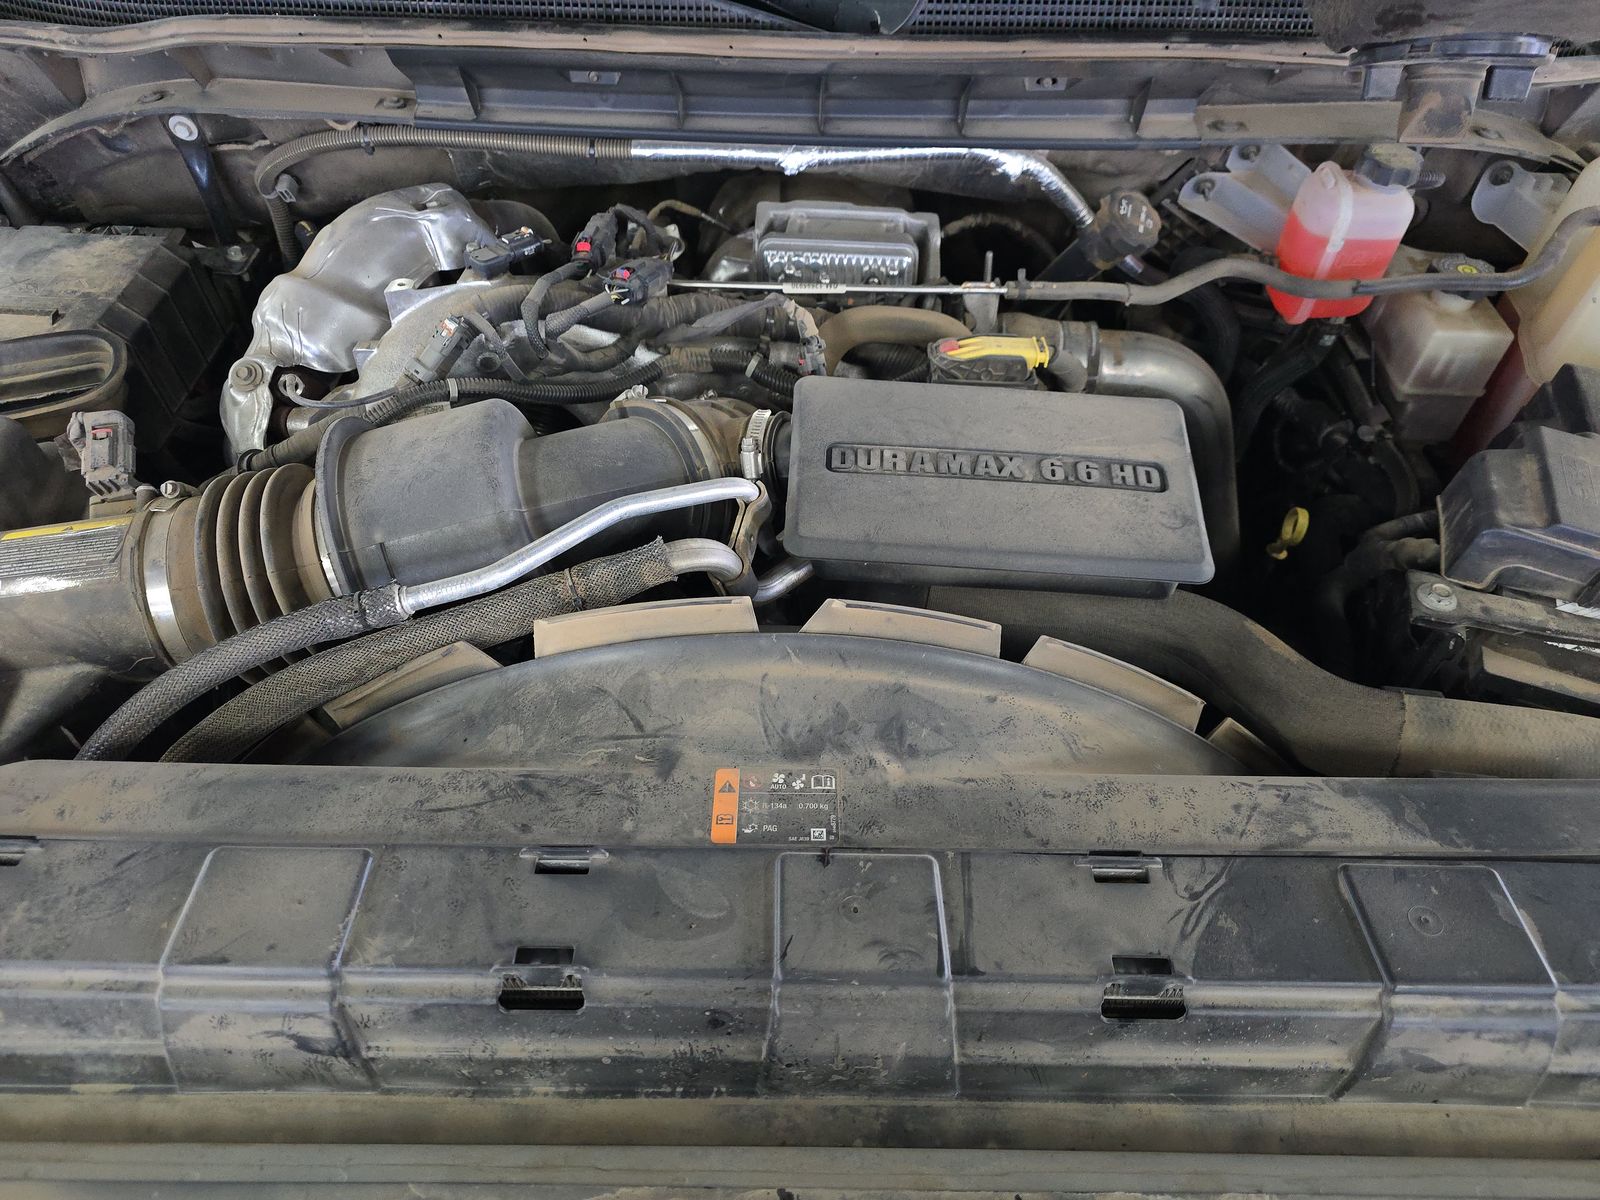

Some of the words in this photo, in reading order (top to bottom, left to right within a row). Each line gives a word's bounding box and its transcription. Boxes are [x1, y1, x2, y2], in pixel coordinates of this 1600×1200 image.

[831, 446, 1023, 479] DURAMAX
[1039, 457, 1101, 483] 6.6
[1112, 463, 1163, 488] HD
[819, 802, 829, 810] kg
[762, 824, 778, 832] PAG
